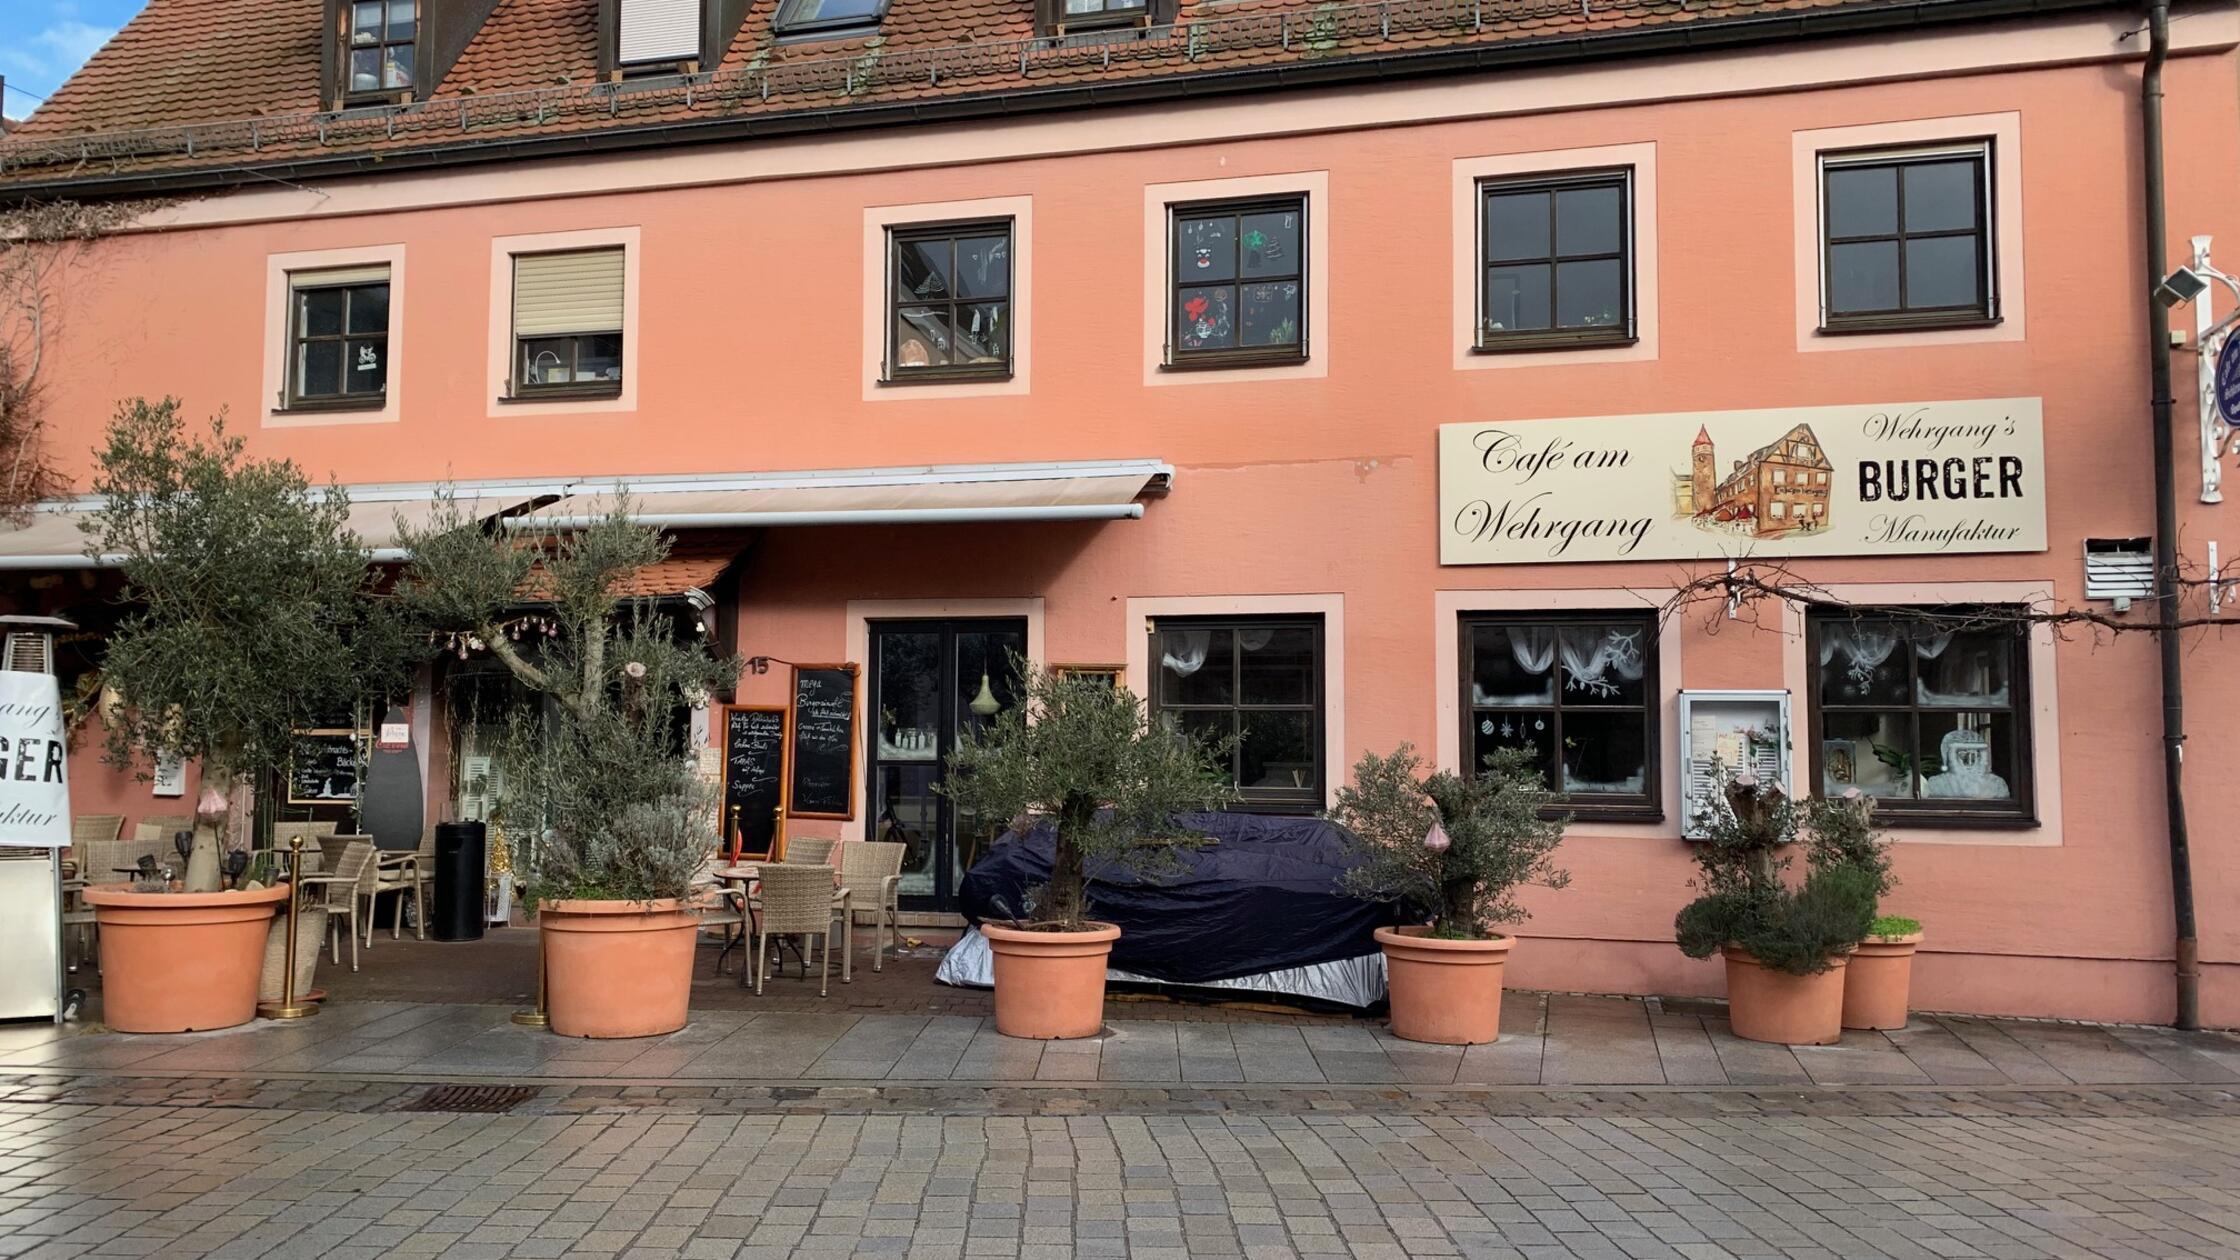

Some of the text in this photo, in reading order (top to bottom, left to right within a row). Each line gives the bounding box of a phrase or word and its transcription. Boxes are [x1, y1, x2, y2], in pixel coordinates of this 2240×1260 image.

[1863, 407, 2015, 450] Wehrgang's
[1472, 429, 1633, 486] Café am
[1859, 455, 2023, 502] BURGER
[1454, 491, 1655, 557] Wehrgang
[1864, 513, 2021, 550] Manufaktur
[751, 656, 769, 675] 15
